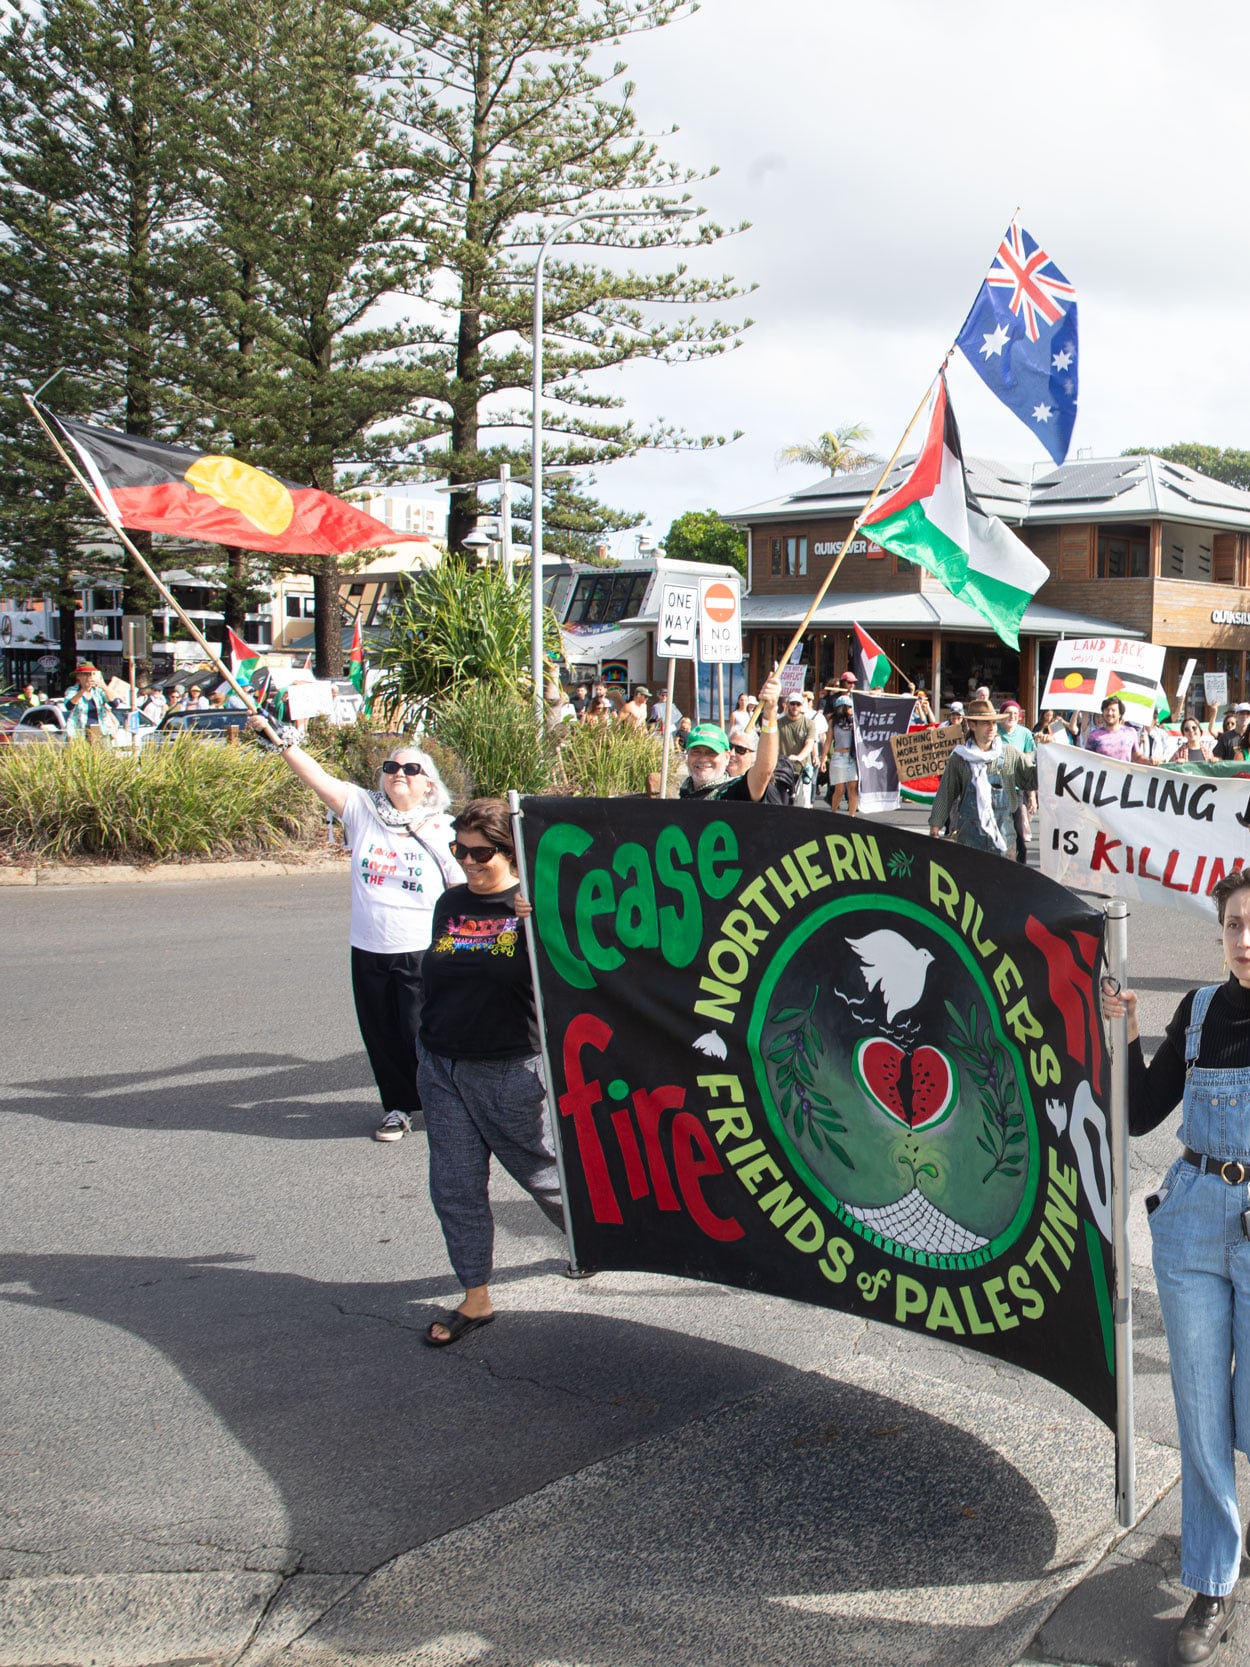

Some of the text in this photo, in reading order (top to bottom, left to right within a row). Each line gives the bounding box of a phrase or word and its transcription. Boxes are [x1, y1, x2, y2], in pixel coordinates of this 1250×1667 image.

[814, 540, 867, 556] QUIKSVER
[668, 592, 692, 609] ONE
[665, 614, 692, 630] WAY
[711, 628, 731, 641] NO
[704, 644, 738, 655] ENTRY
[1073, 639, 1146, 657] LAND BACK
[859, 711, 897, 726] FREE
[896, 730, 946, 748] NOTHING IS
[897, 737, 962, 758] MORE IMPORTANT
[899, 756, 919, 766] THAN
[1056, 763, 1218, 821] KILLING
[1052, 829, 1079, 855] IS
[404, 852, 424, 861] THE
[361, 858, 422, 876] RIVER TO
[362, 873, 423, 893] THE SEA
[534, 820, 743, 989] Cease
[693, 833, 1061, 1087] NORTHERN RIVERS
[558, 1013, 746, 1242] fire
[697, 1074, 1078, 1335] FRIENDS of PALESTINE
